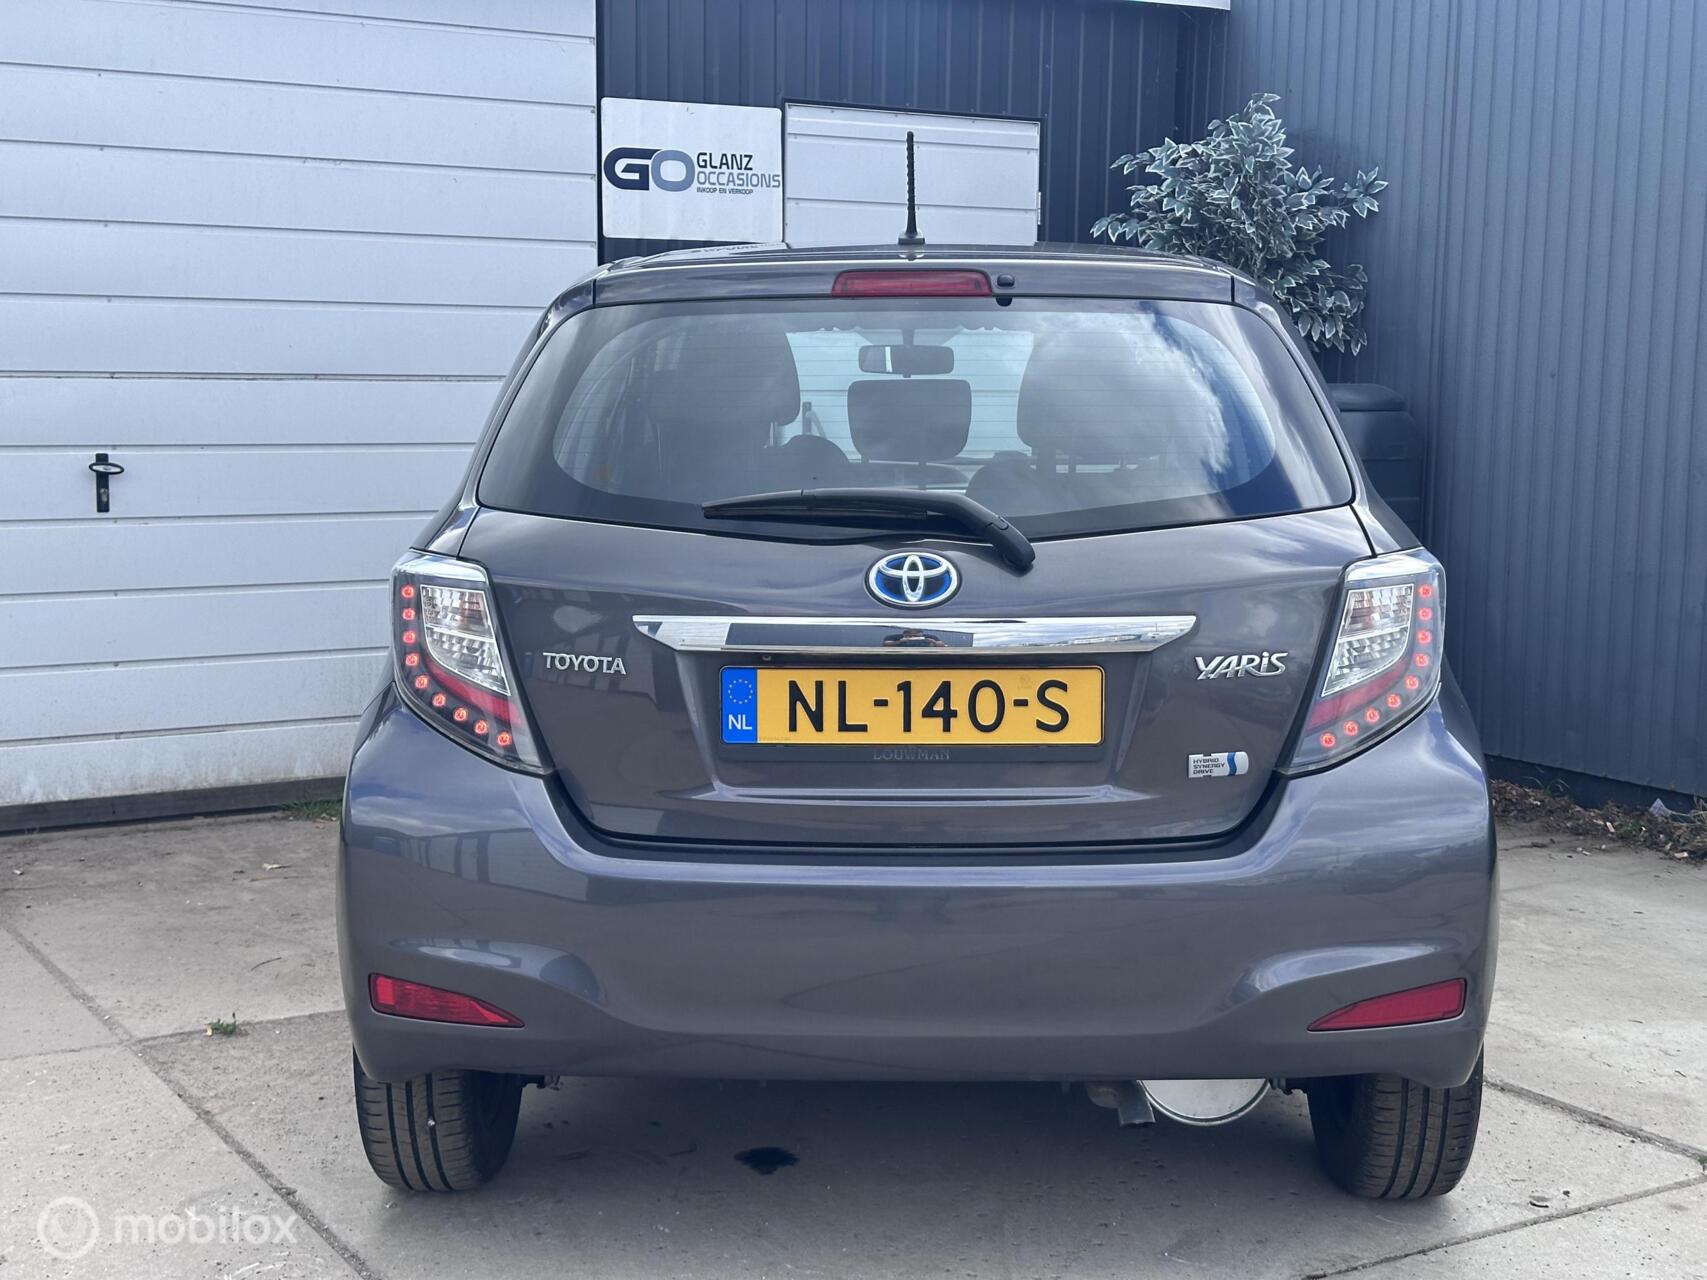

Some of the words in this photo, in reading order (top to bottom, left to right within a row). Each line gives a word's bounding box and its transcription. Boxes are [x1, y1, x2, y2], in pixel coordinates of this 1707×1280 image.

[603, 147, 696, 192] GO
[696, 152, 753, 171] GLANZ
[696, 171, 781, 188] OCCASIONS
[542, 652, 627, 675] TOYOTA
[788, 679, 1070, 733] NL-140-S
[728, 714, 753, 730] NL
[872, 748, 951, 761] LOUWMAN
